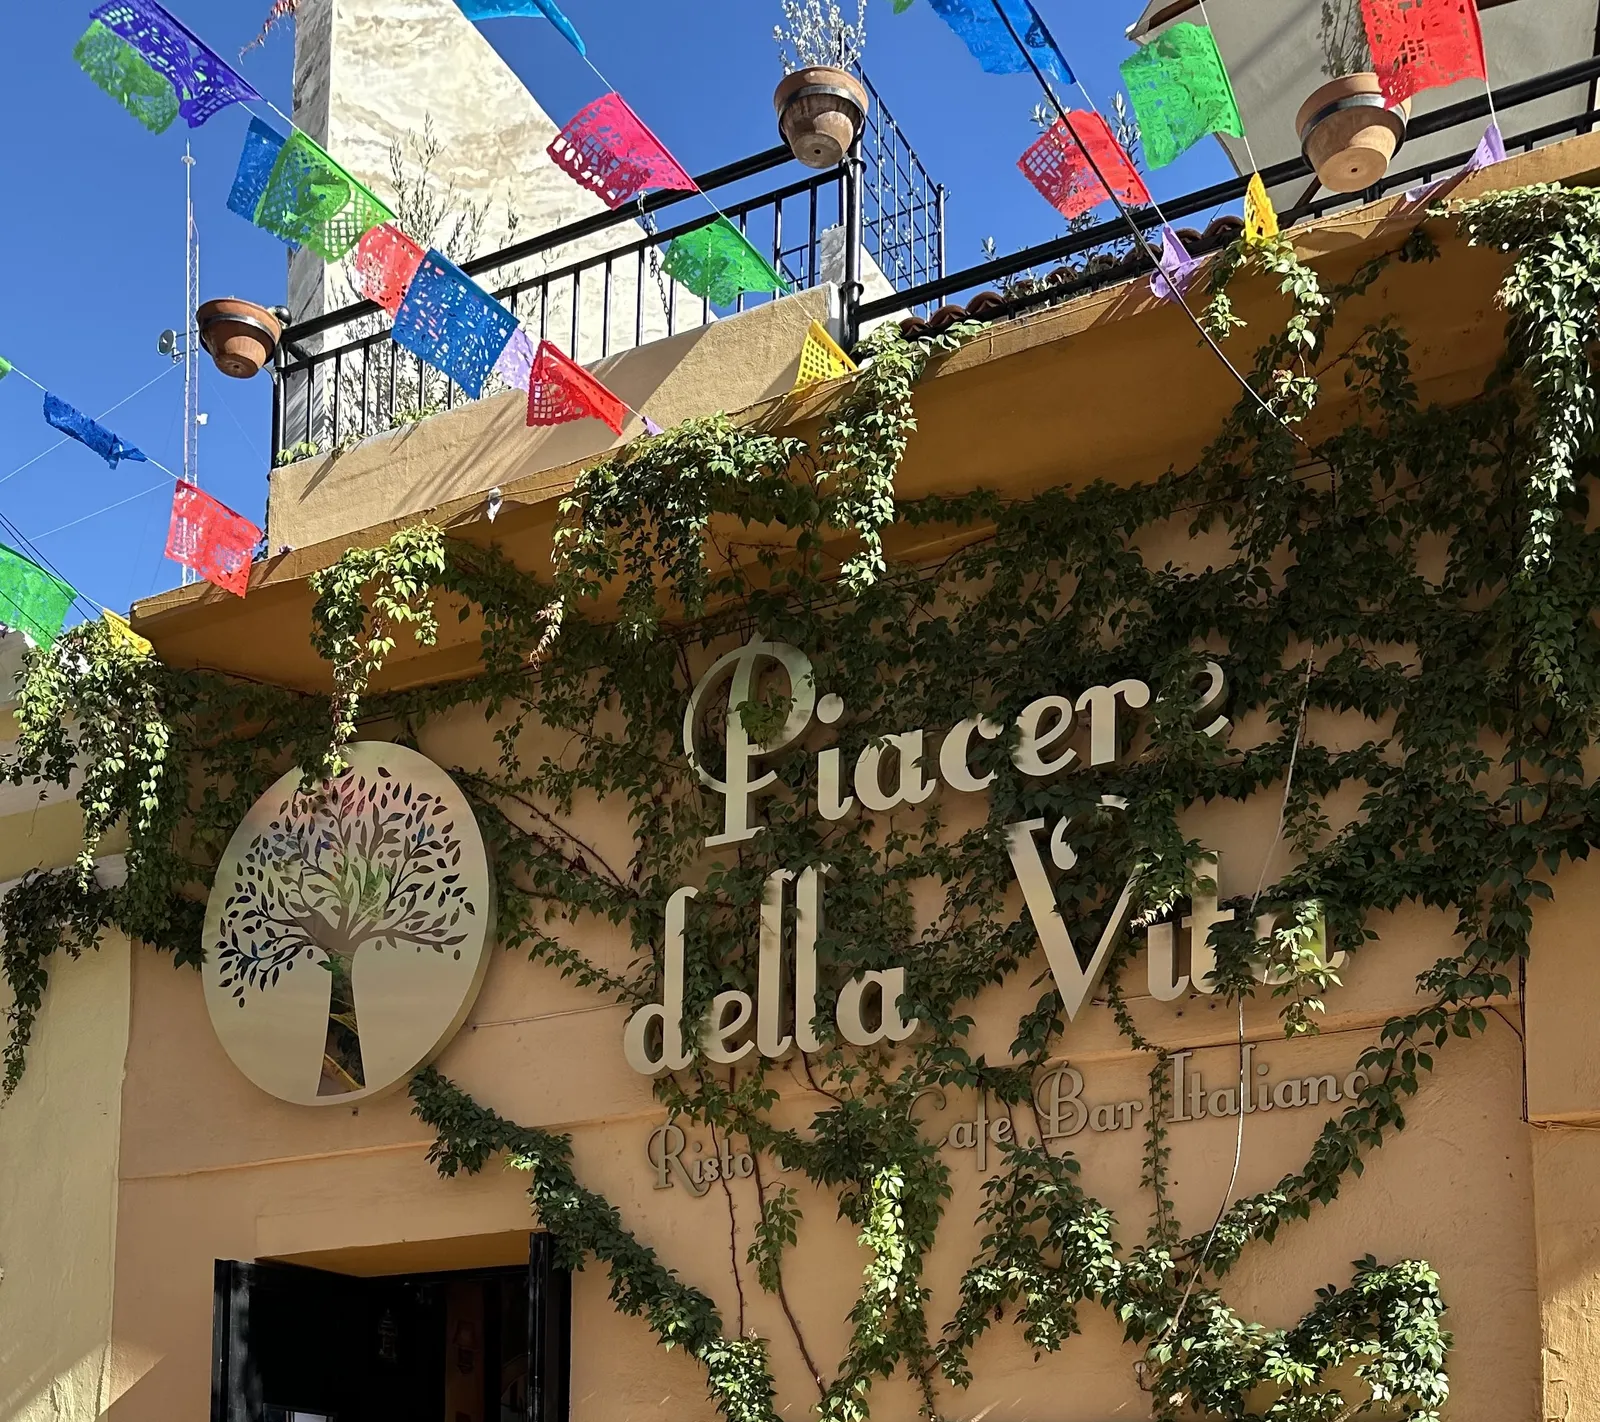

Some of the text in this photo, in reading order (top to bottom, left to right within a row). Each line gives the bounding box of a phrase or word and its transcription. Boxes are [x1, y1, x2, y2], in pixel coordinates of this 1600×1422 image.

[683, 633, 1230, 848] Piacere
[623, 794, 1347, 1075] della Vita
[647, 1117, 755, 1197] Risto
[1032, 1061, 1143, 1140] Bar
[1166, 1043, 1369, 1124] Italiano
